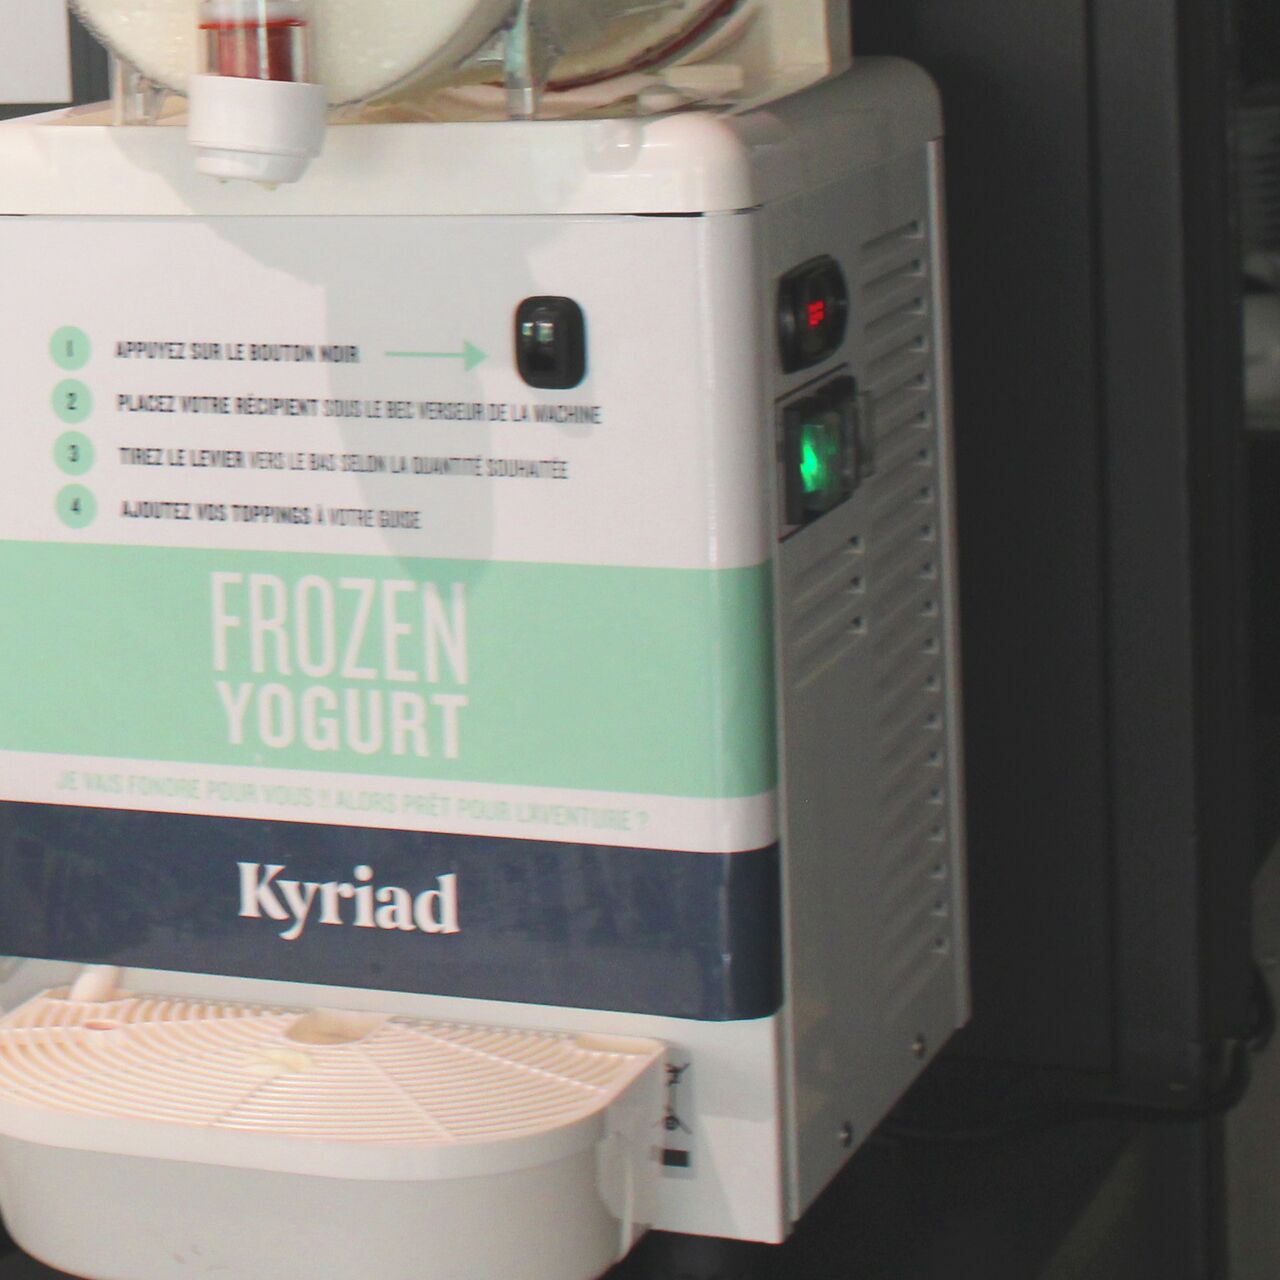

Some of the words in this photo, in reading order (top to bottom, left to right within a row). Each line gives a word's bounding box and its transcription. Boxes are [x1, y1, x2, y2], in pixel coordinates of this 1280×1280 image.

[115, 340, 186, 360] APPUYEZ
[191, 341, 223, 361] SUR
[226, 342, 245, 361] LE
[250, 343, 316, 362] BOUTON
[319, 345, 360, 363] NOIR
[65, 391, 78, 411] 2
[118, 393, 176, 413] PLACEZ
[181, 395, 231, 414] VOTRE
[235, 392, 318, 417] RÉCIPIENT
[321, 398, 360, 418] SOUS
[364, 400, 381, 419] LE
[386, 400, 414, 420] BEC
[418, 401, 484, 421] VERSEUR
[488, 403, 507, 422] DE
[510, 403, 529, 422] LA
[533, 404, 602, 425] MACHINE
[67, 443, 80, 463] 3
[119, 447, 163, 466] TIREZ
[169, 448, 185, 466] LE
[191, 449, 245, 468] LEVIER
[250, 450, 286, 470] VERS
[290, 452, 307, 471] LE
[310, 452, 337, 472] BAS
[341, 454, 386, 473] SELON
[391, 455, 409, 474] LA
[70, 496, 81, 516] 4
[121, 500, 190, 520] AJOUTEZ
[196, 503, 227, 522] VOS
[231, 504, 311, 525] TOPPINGS
[329, 508, 375, 528] VOTRE
[378, 509, 422, 530] GUISE
[210, 571, 468, 685] FROZEN
[215, 680, 469, 760] YOGURT
[236, 861, 462, 941] Kyriad
